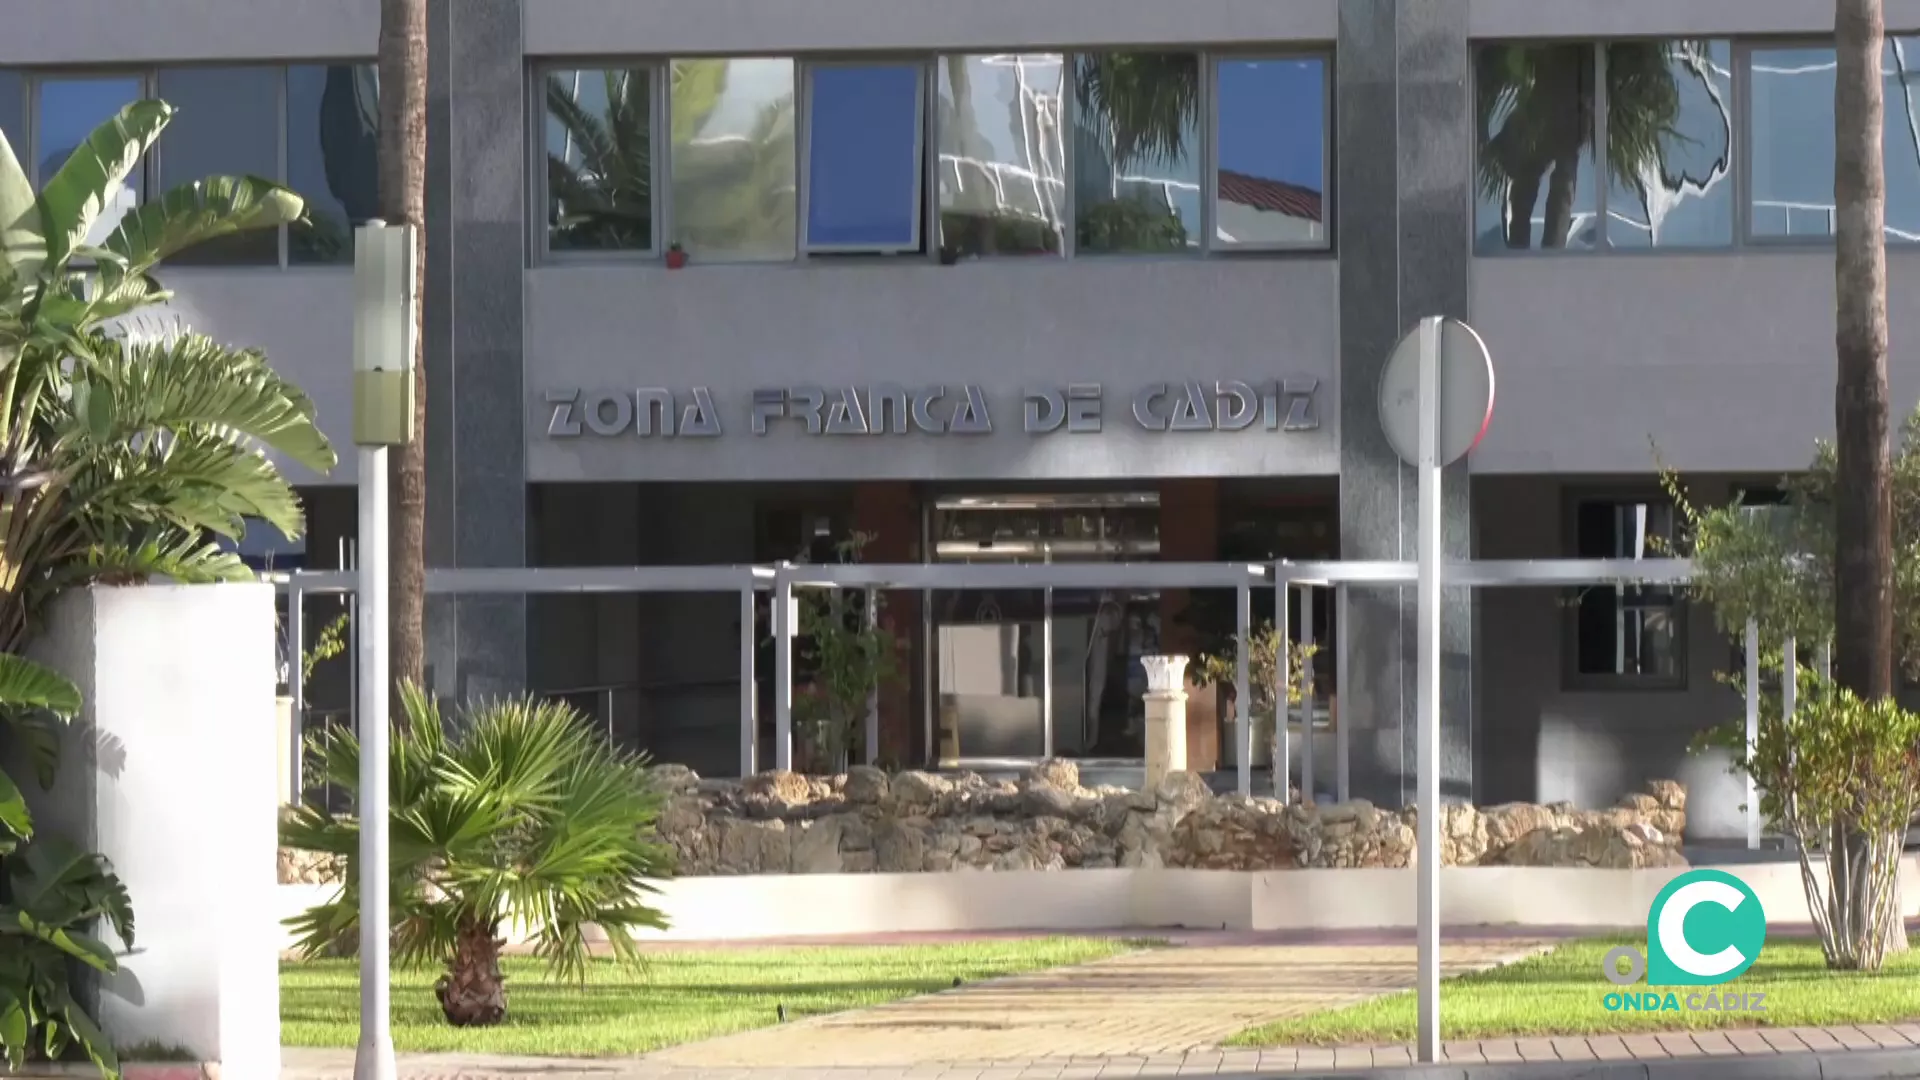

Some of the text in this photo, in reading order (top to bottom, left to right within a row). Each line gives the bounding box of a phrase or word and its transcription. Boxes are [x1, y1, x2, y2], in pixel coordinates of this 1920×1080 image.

[546, 379, 1319, 436] ZONA FRANCA DE CADIZ
